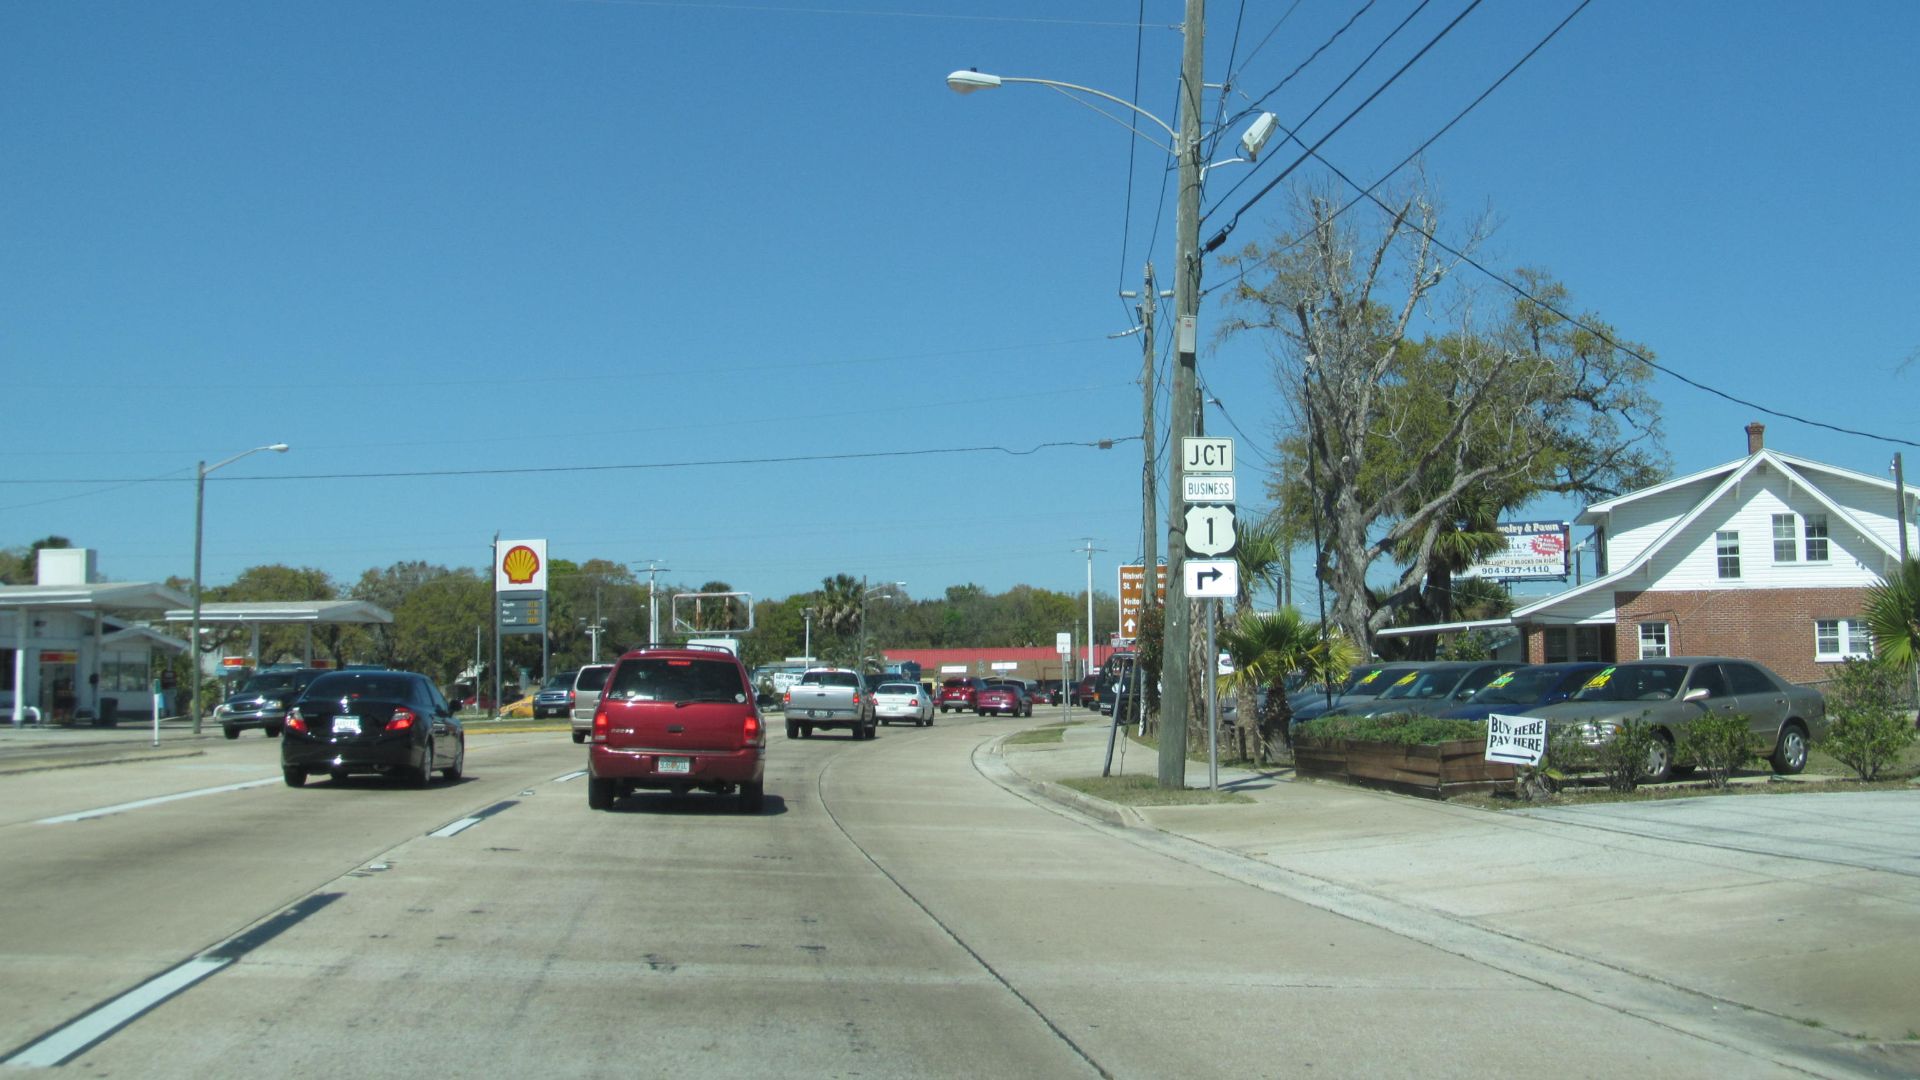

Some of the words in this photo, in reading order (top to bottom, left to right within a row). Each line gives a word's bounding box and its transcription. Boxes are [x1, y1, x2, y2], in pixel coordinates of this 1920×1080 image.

[1189, 444, 1227, 466] JCT
[1188, 482, 1230, 496] BUSINESS
[1206, 517, 1214, 546] 1
[1524, 523, 1532, 532] &
[1533, 523, 1560, 532] Pawn
[1491, 716, 1511, 735] BUY
[1514, 721, 1543, 735] HERE
[1490, 735, 1510, 748] PAY
[1513, 737, 1542, 752] HERE
